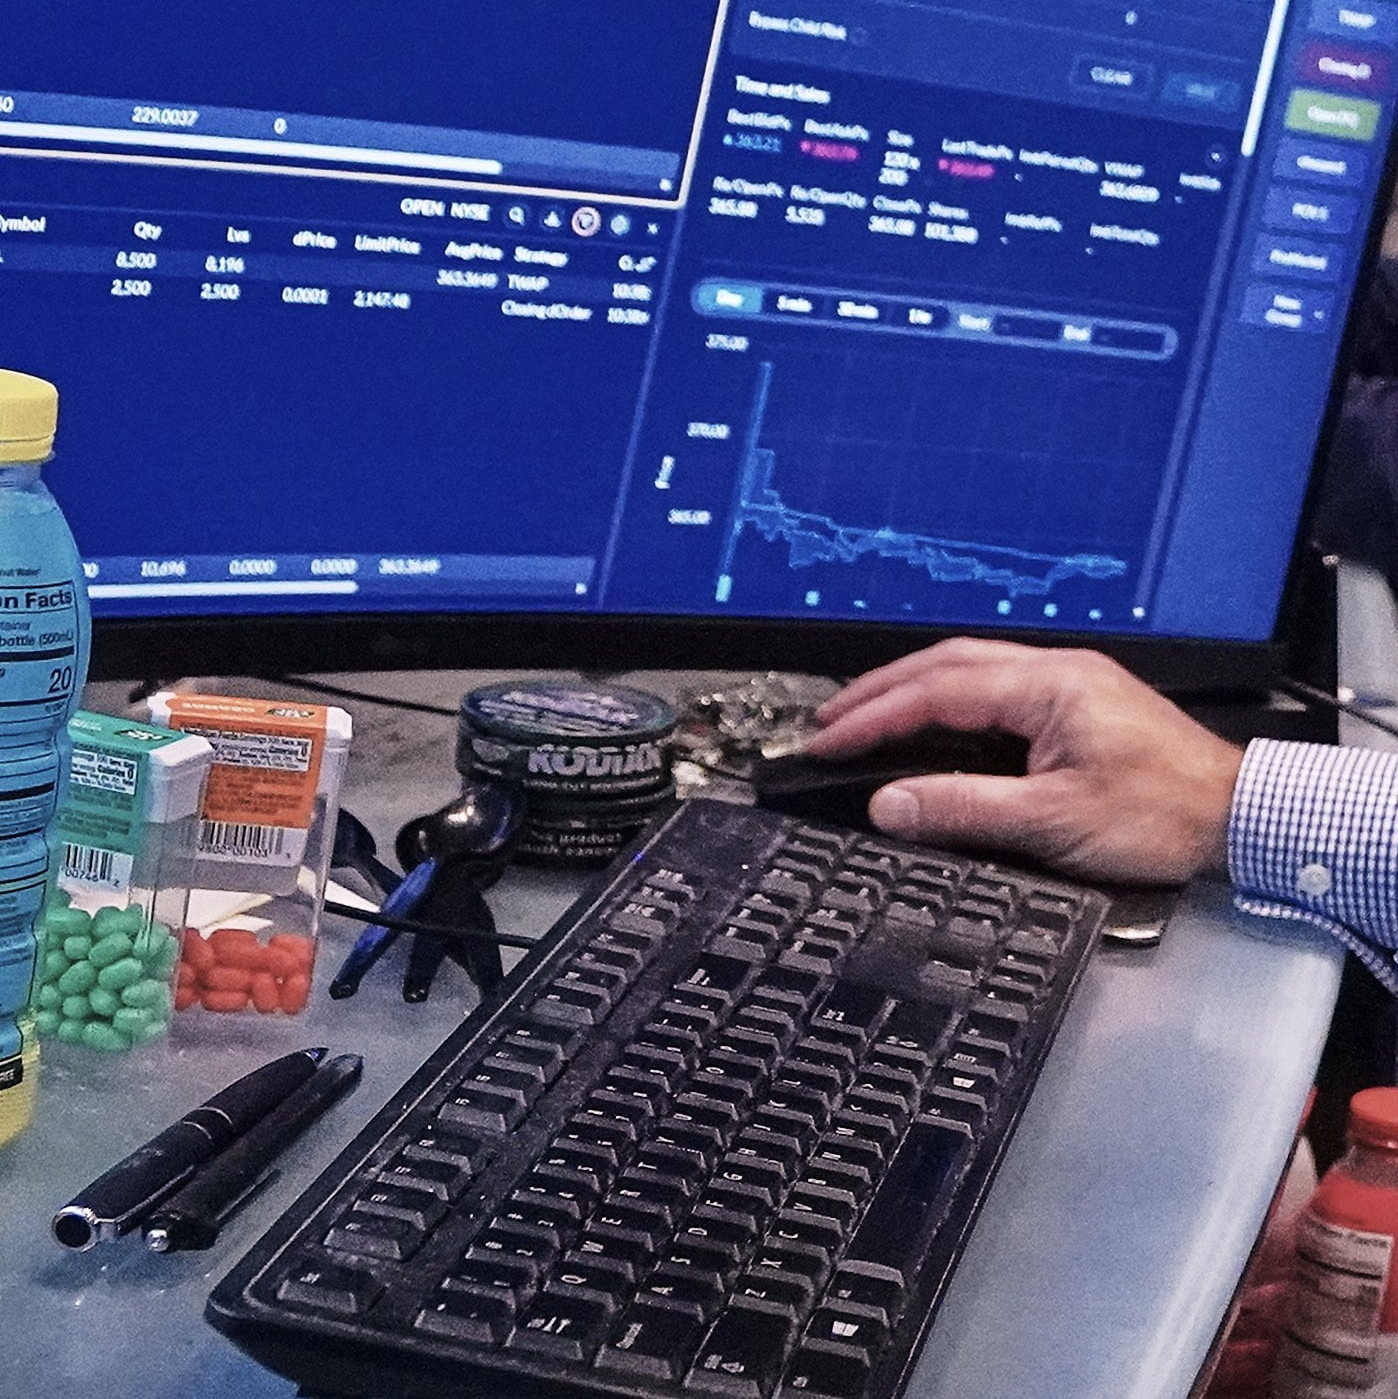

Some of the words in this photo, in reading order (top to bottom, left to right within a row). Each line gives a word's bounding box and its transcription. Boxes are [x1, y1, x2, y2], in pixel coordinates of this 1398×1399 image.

[273, 117, 288, 136] 0
[0, 214, 46, 234] ymbol
[133, 220, 162, 240] Qty
[26, 590, 72, 608] Facts
[49, 666, 72, 695] 20
